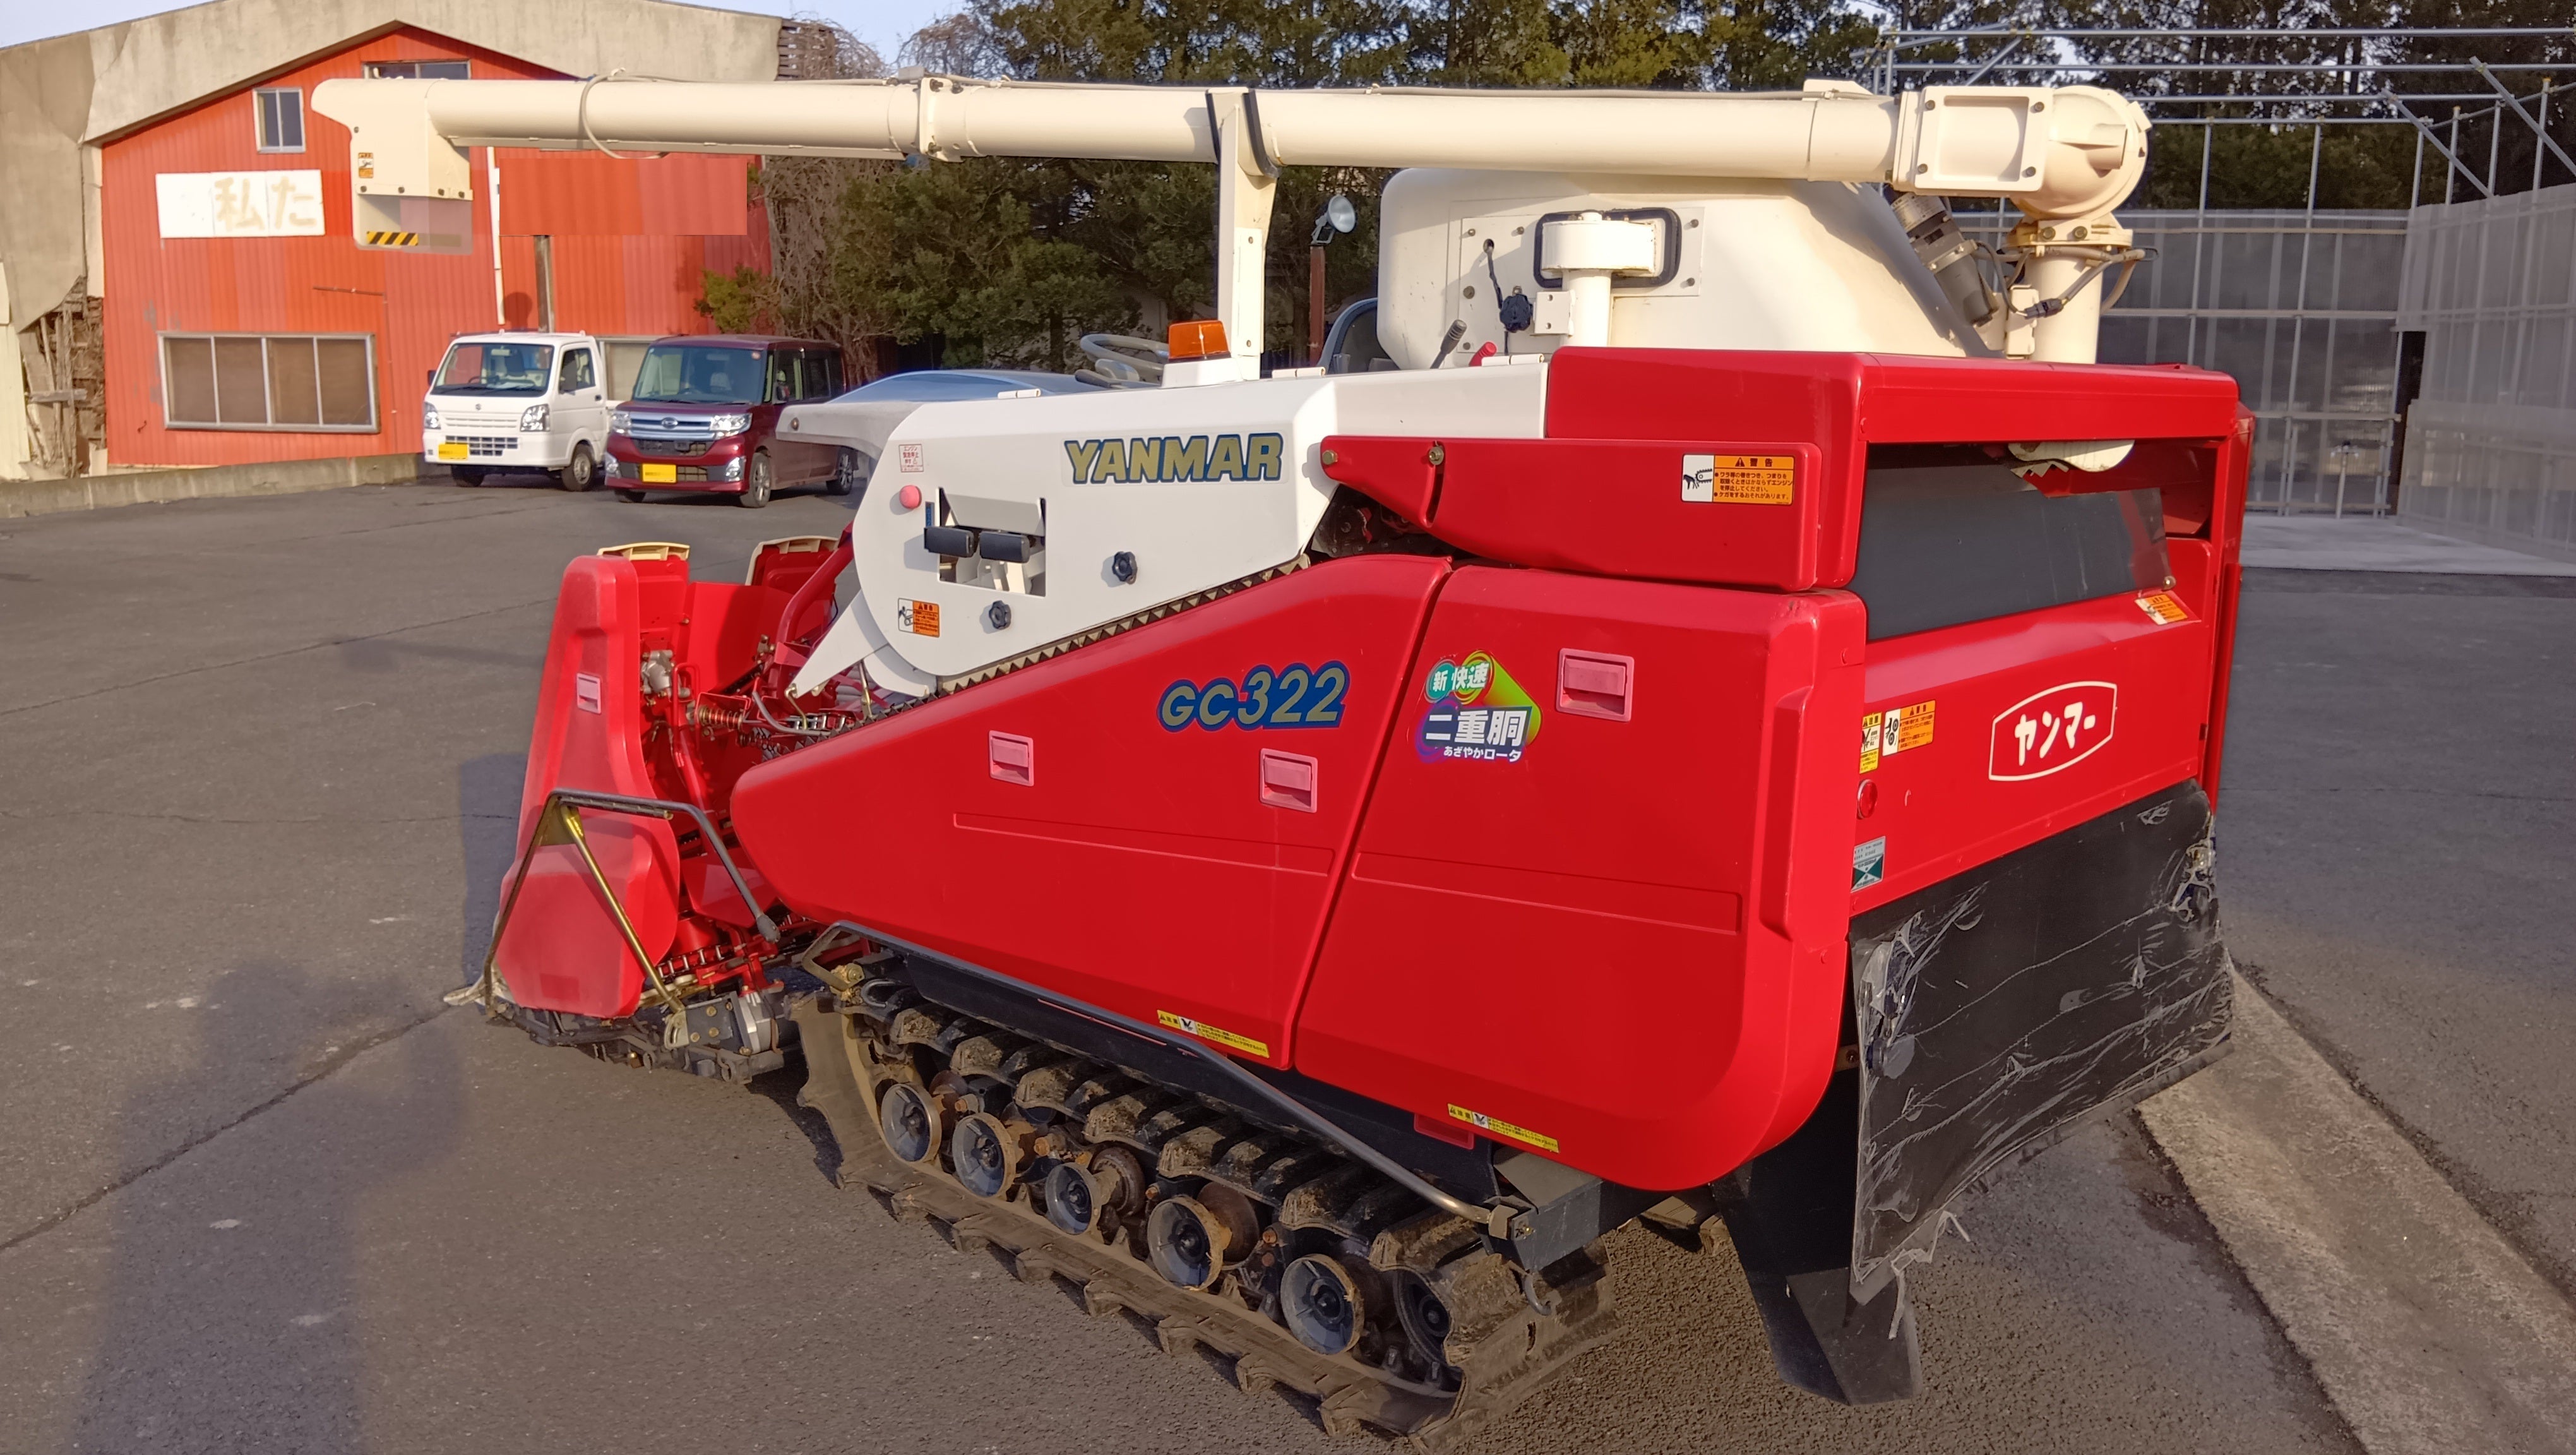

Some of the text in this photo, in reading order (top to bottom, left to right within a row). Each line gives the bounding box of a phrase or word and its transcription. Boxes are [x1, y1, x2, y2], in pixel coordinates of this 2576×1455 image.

[1064, 433, 1284, 484] YANMAR
[1750, 458, 1773, 467] 警告
[1159, 662, 1348, 730] GC322
[1426, 710, 1527, 747] 二重胴
[2014, 701, 2096, 767] ヤンマー
[1443, 746, 1522, 762] あざやかロータ
